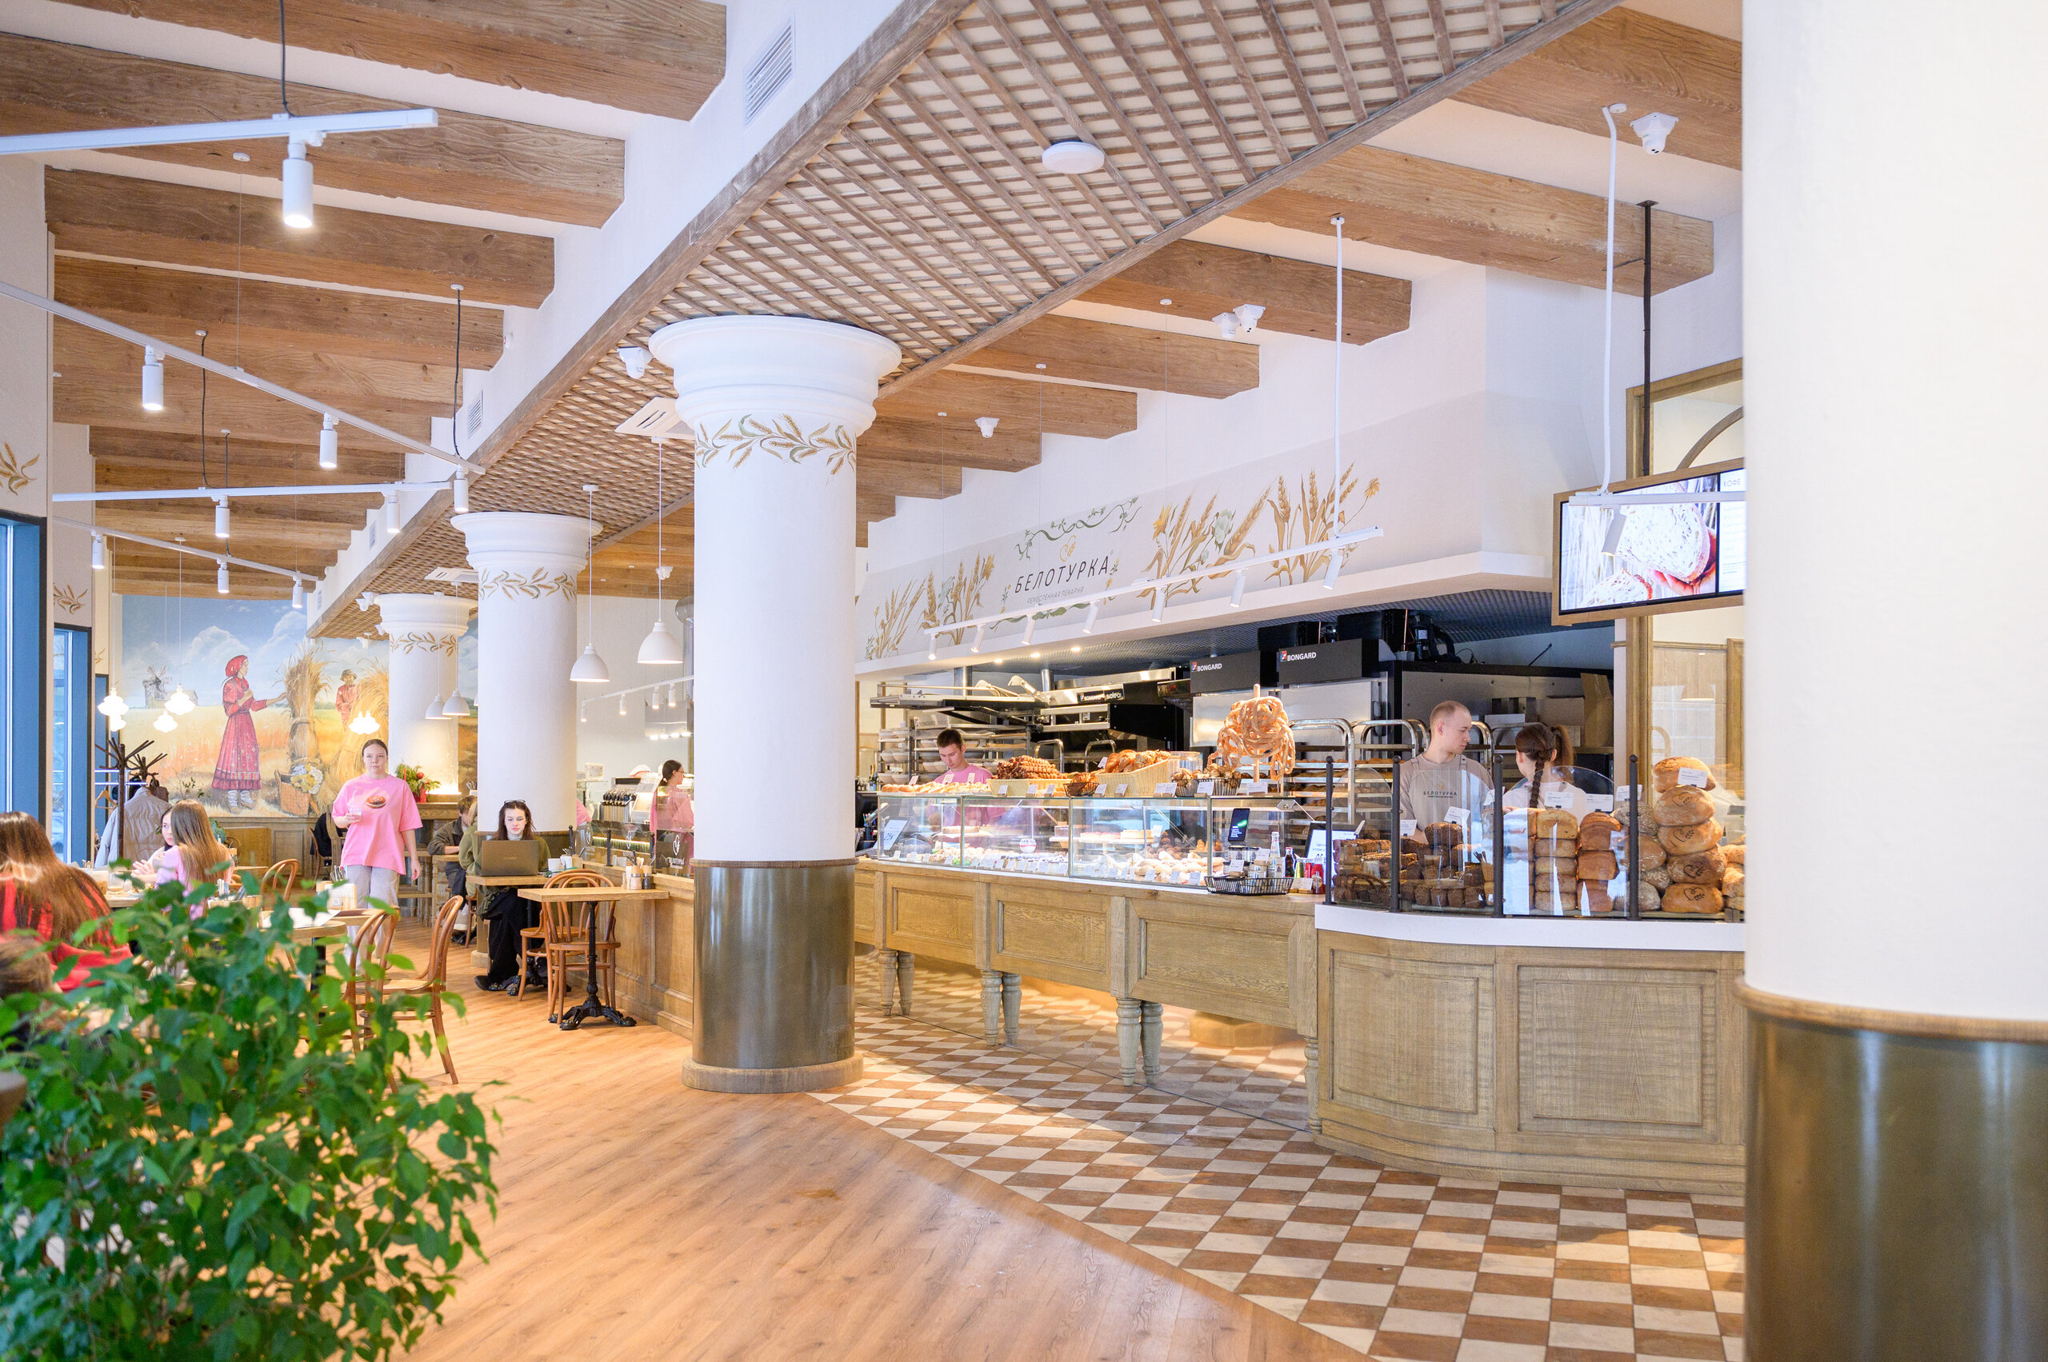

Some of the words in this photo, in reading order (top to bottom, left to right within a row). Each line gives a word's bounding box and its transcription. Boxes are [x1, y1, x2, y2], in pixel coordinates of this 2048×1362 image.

[1014, 555, 1109, 594] БЕЛОТУРКА
[1286, 651, 1317, 662] BONGARD
[1196, 663, 1223, 672] BONGARD
